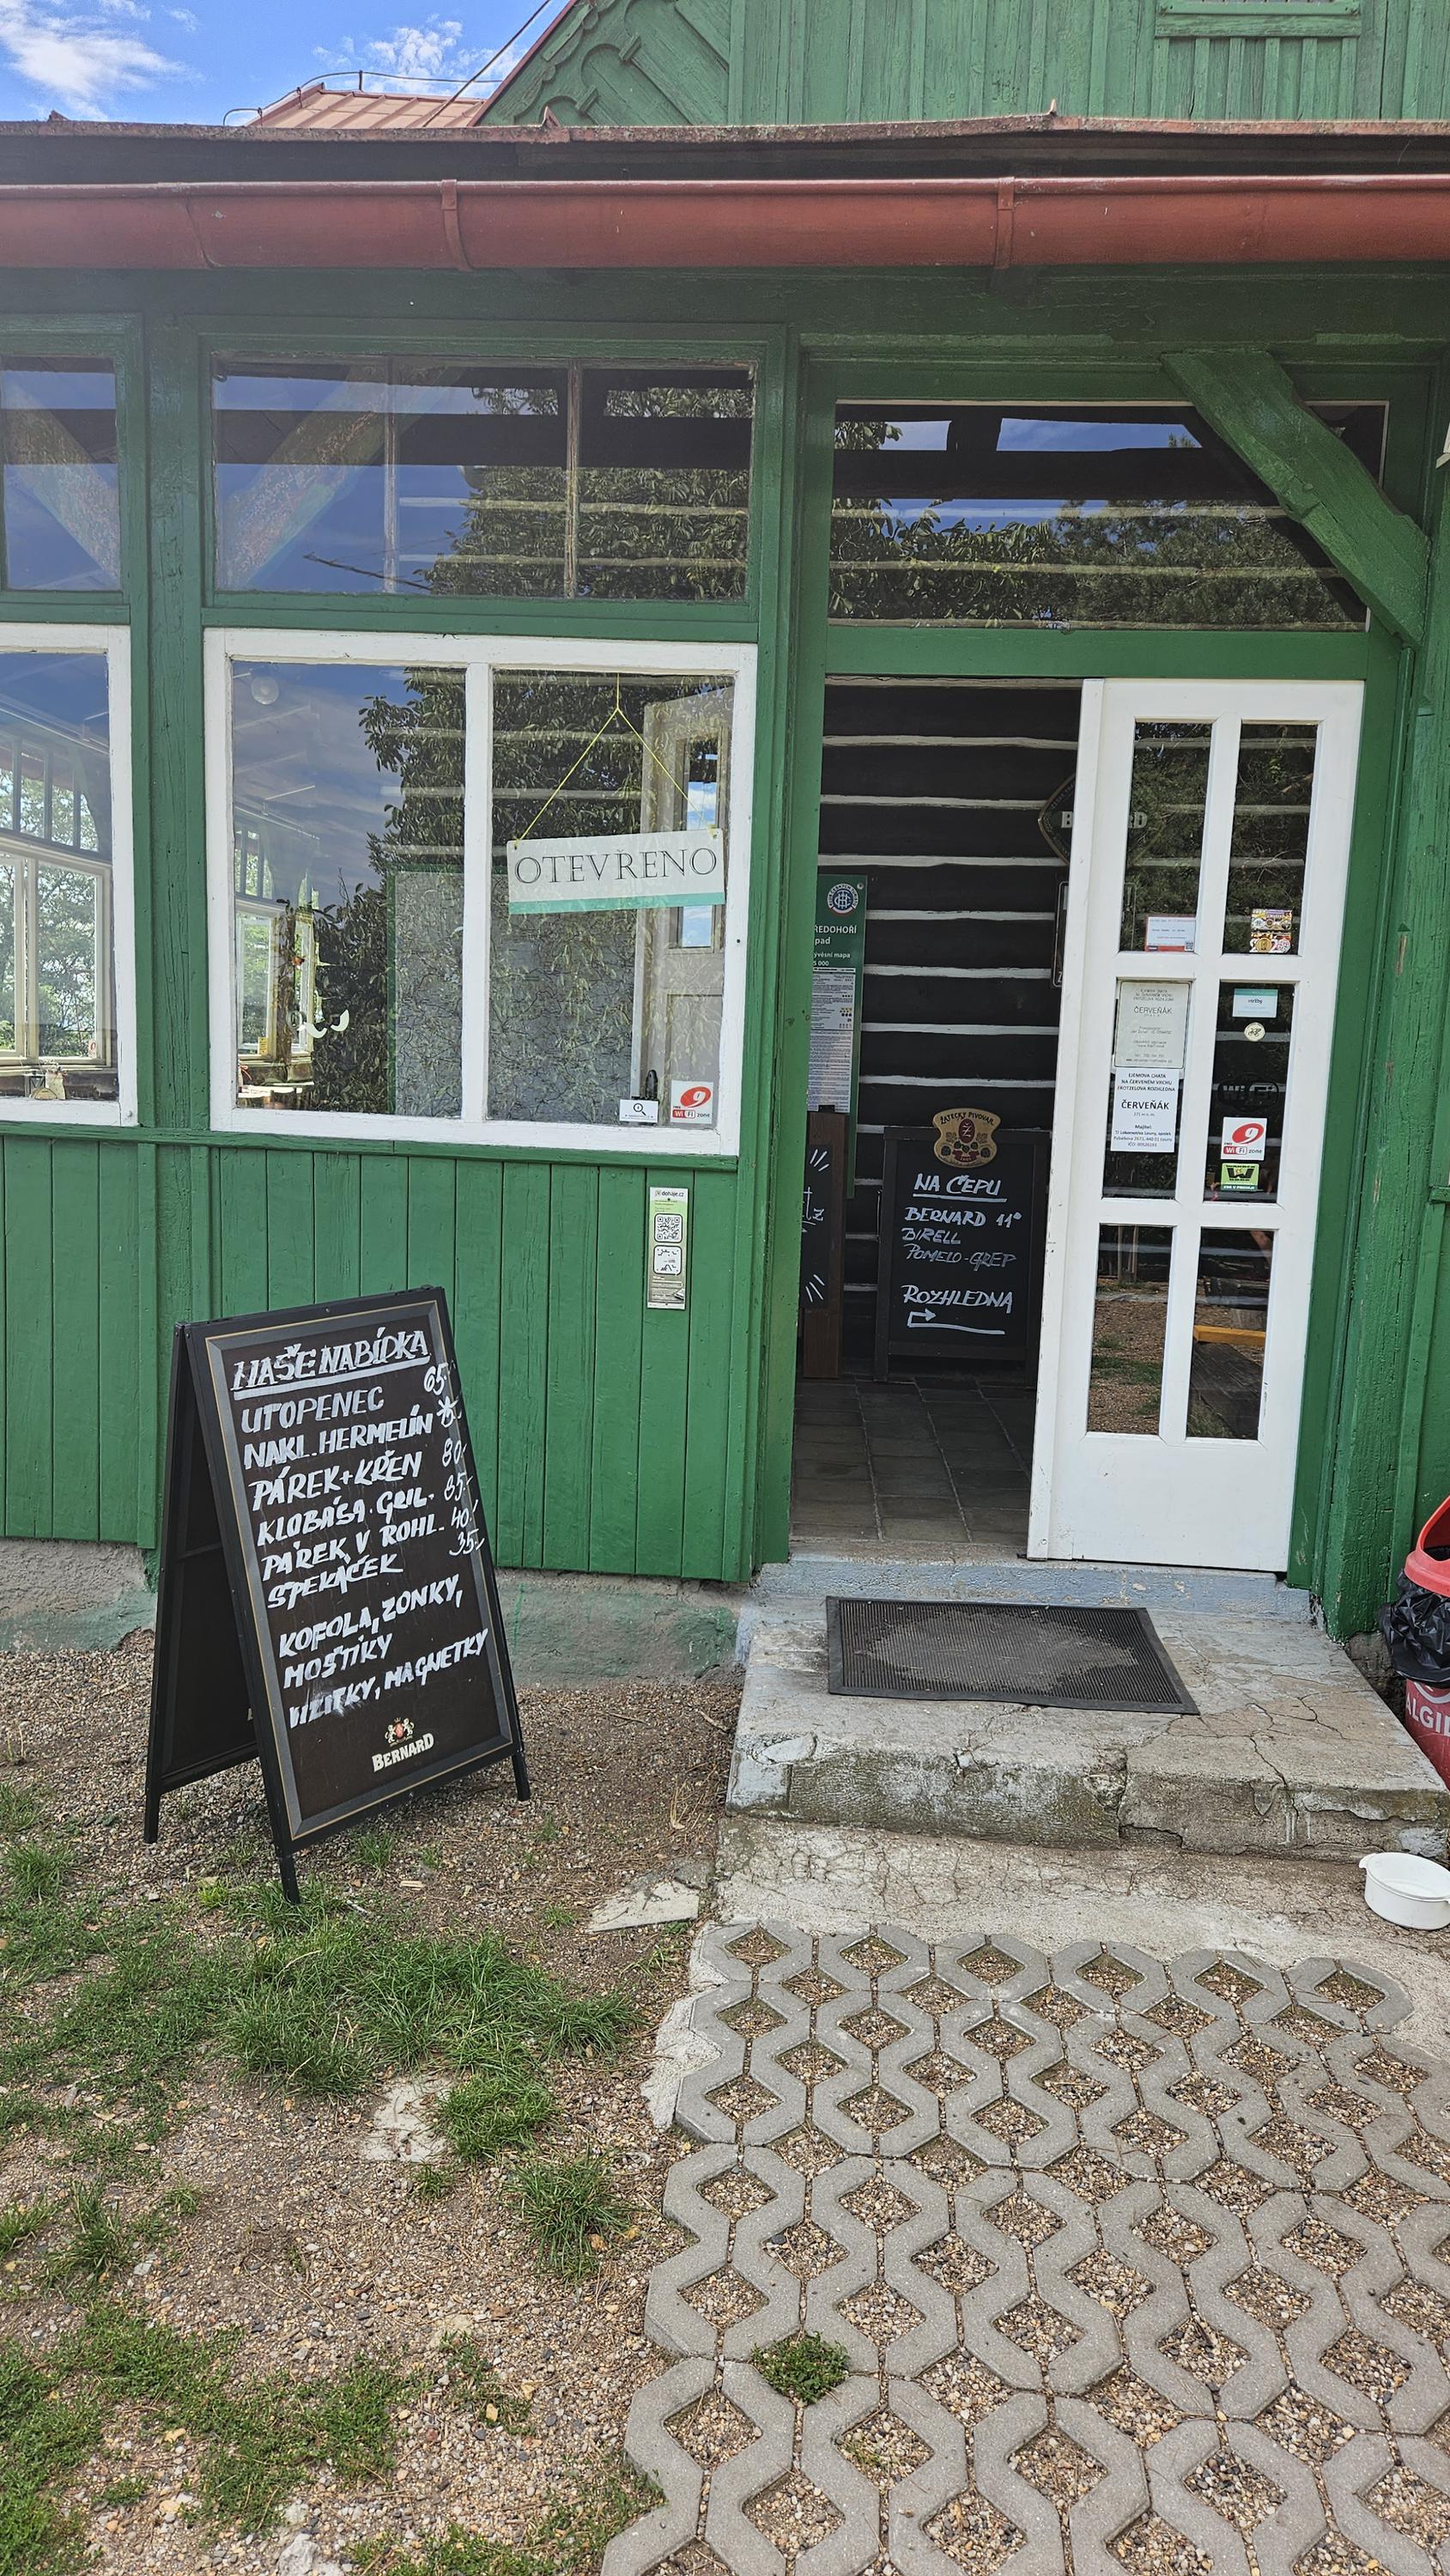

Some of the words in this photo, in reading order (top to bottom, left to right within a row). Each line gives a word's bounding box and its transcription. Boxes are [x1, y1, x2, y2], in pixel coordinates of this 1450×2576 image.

[514, 846, 718, 885] OTEVŘENO
[1133, 1005, 1173, 1014] ČERVEŇÁK
[968, 1111, 995, 1127] PIVOVAR
[1121, 1099, 1169, 1109] ČERVEŇÁK
[913, 1173, 941, 1192] NA
[945, 1173, 1002, 1196] ČEPU
[901, 1227, 962, 1245] BIRELL
[904, 1206, 986, 1227] BERNARD
[901, 1284, 1014, 1314] ROZHLEDNA
[230, 1343, 317, 1391] NAŠE
[318, 1327, 430, 1375] NABÍDKA
[241, 1386, 385, 1433] UTOPENEC
[319, 1404, 433, 1455] HERMELÍN
[261, 1537, 347, 1582] PÁREK
[355, 1530, 372, 1555] V
[279, 1606, 379, 1658] KOFOLA,
[381, 1573, 464, 1623] ZONKY,
[383, 1628, 489, 1690] MAGNETKY
[371, 1732, 435, 1772] BERNARD
